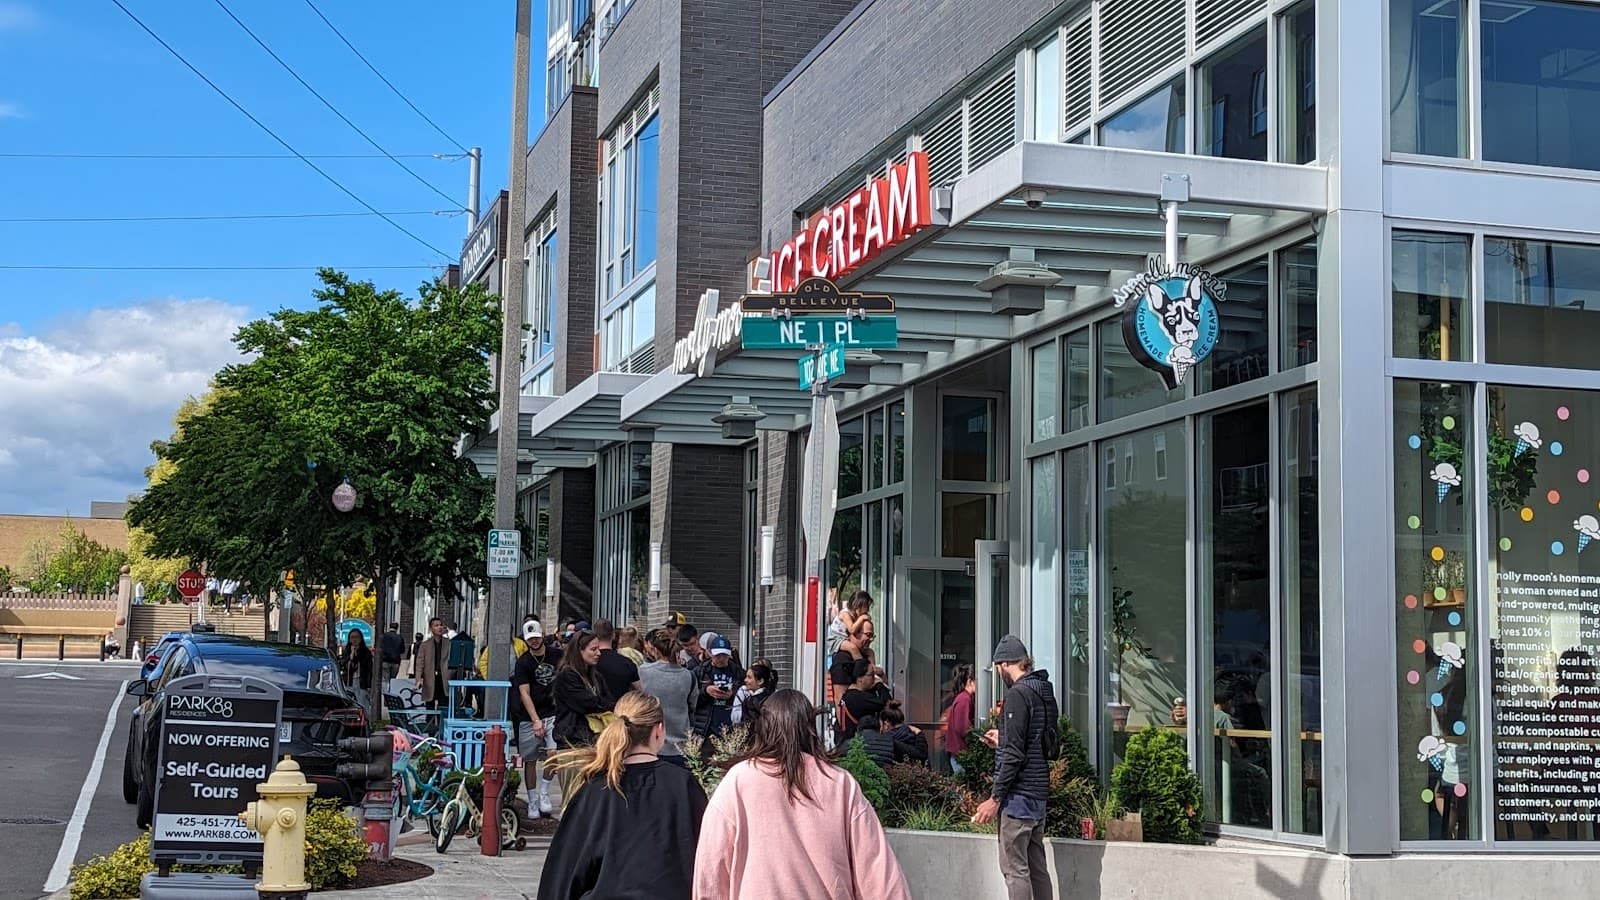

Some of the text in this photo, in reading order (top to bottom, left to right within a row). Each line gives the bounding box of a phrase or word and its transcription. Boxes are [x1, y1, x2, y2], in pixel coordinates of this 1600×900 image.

[770, 153, 922, 292] ICE CREAM
[1134, 254, 1175, 298] molly
[1175, 261, 1228, 302] moon's
[804, 283, 831, 293] OLD
[779, 298, 860, 306] BELLEVUE
[779, 320, 860, 344] NE 1 PL
[1138, 307, 1164, 360] HOMEMADE
[1195, 309, 1217, 359] ICE CREAM
[804, 348, 840, 385] 102 AVE NE
[490, 532, 498, 545] 2
[179, 577, 206, 589] STOP
[1523, 572, 1558, 582] moon's
[1511, 587, 1546, 596] woman
[1547, 588, 1579, 597] owned
[1580, 588, 1598, 598] and
[1568, 601, 1600, 615] multig
[1495, 614, 1600, 628] community athering
[1522, 628, 1541, 637] 10%
[1495, 642, 1551, 652] community
[1495, 669, 1560, 682] local/organic
[1561, 670, 1590, 680] farms
[170, 695, 234, 718] PARK88
[1496, 698, 1523, 708] racial
[1524, 699, 1557, 711] equity
[1558, 699, 1577, 709] and
[1496, 711, 1541, 722] delicious
[1541, 712, 1557, 722] ice
[1558, 714, 1590, 723] cream
[1496, 725, 1524, 736] 100%
[1525, 726, 1589, 738] compostable
[168, 733, 270, 749] NOW OFFERING
[1497, 741, 1532, 751] straws,
[1533, 740, 1552, 751] and
[1552, 741, 1593, 753] napkins,
[1497, 755, 1514, 764] our
[1515, 754, 1570, 767] employees
[1571, 756, 1593, 765] with
[166, 760, 267, 780] Self-Guided
[1497, 768, 1542, 780] benefits,
[1543, 769, 1588, 782] including
[190, 782, 239, 799] Tours
[1497, 782, 1597, 794] health insurance. we
[1498, 797, 1554, 809] customers,
[1554, 799, 1572, 808] our
[1498, 811, 1596, 824] community, and our
[164, 829, 258, 840] www.PARK88.COM
